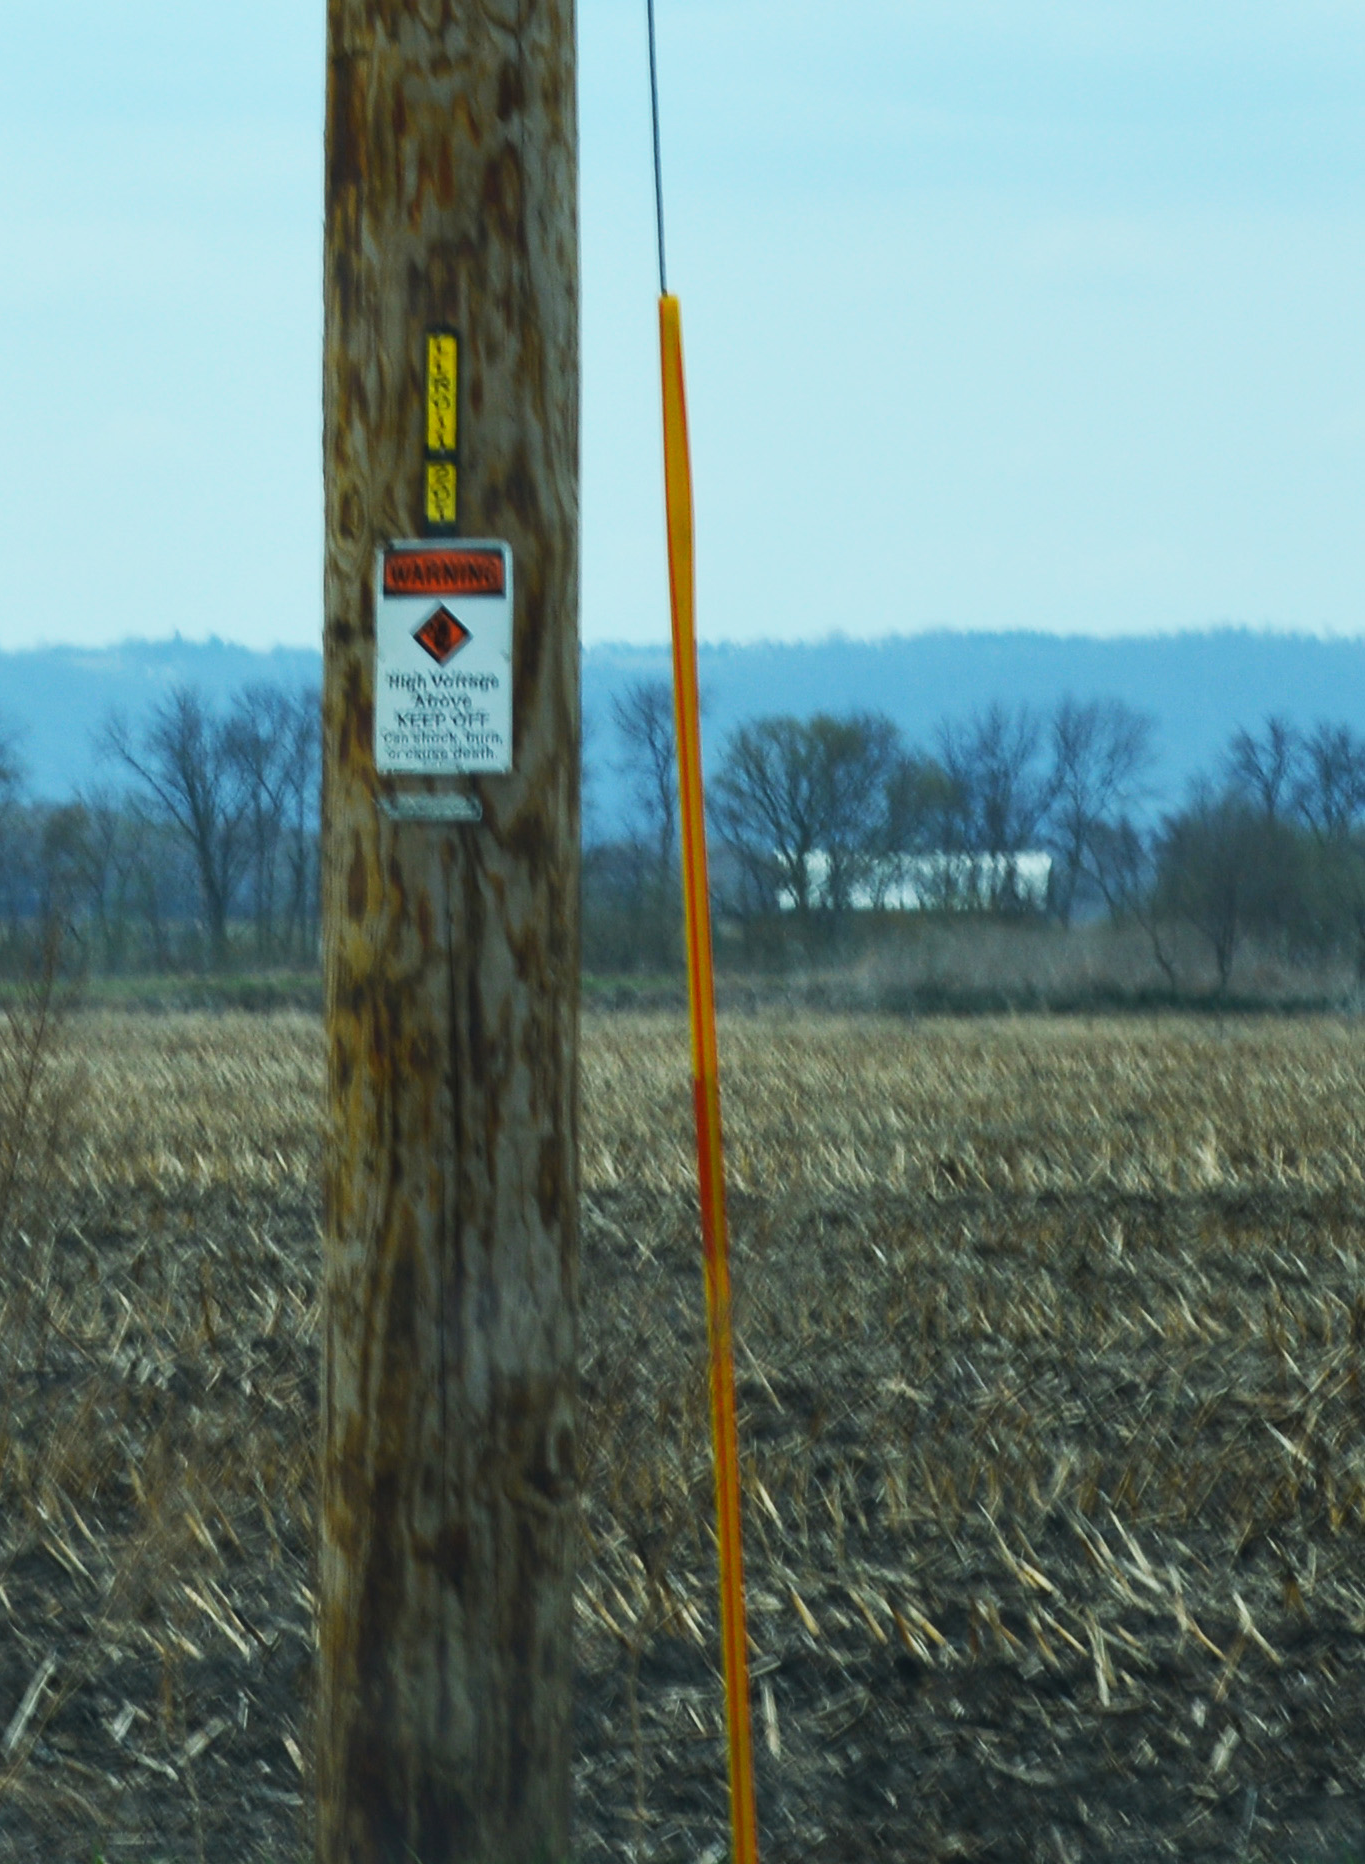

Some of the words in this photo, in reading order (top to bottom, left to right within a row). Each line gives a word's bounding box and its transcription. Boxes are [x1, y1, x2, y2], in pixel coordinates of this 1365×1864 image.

[391, 559, 500, 585] WARNING
[388, 671, 427, 691] High
[430, 670, 499, 691] Voltage
[414, 692, 473, 709] Above
[396, 710, 446, 727] KEEP
[449, 710, 490, 727] OFF
[405, 748, 449, 760] cause
